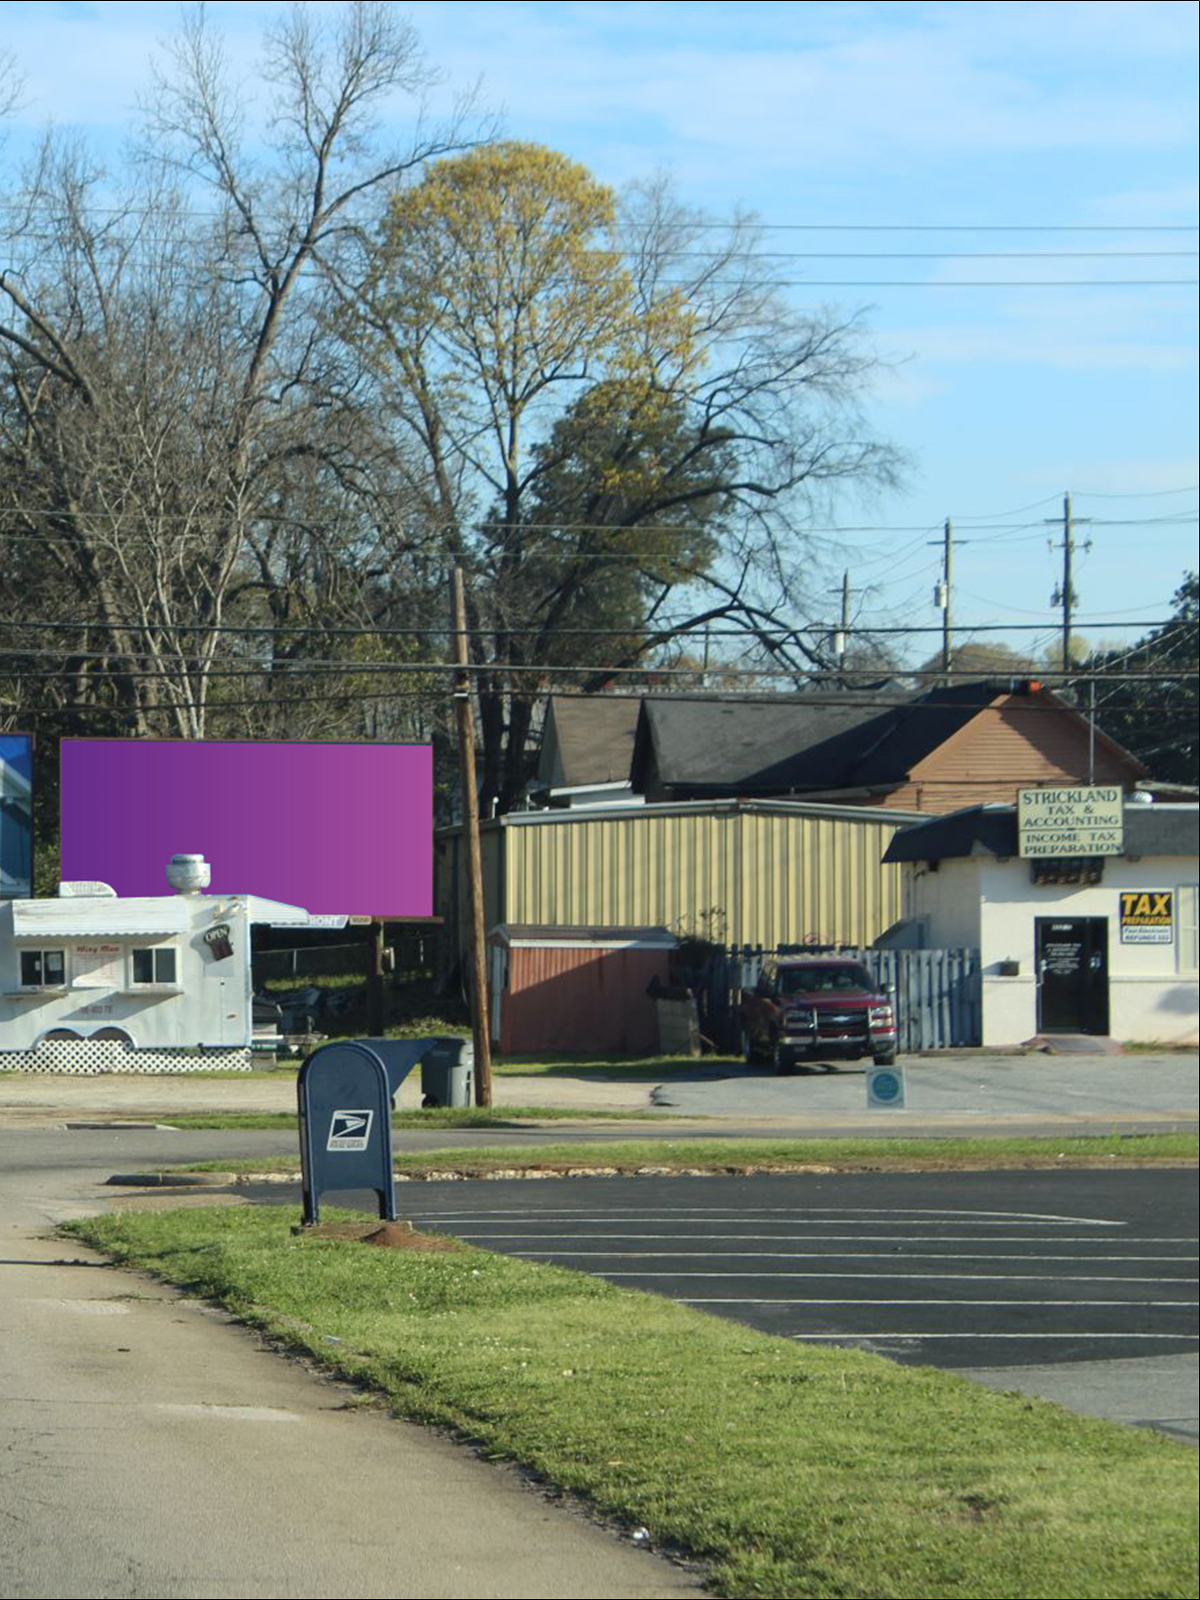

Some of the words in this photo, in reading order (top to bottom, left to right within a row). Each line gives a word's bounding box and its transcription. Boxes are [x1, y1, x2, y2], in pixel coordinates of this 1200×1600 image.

[1023, 790, 1117, 804] STRICKLAND
[1048, 805, 1075, 815] TAX
[1084, 804, 1094, 814] &
[1025, 816, 1118, 827] ACCOUNTING
[1026, 832, 1079, 843] INCOME
[1090, 832, 1115, 841] TAX
[1025, 843, 1124, 854] PREPARATION
[1122, 894, 1171, 915] TAX
[206, 926, 229, 942] OPEN
